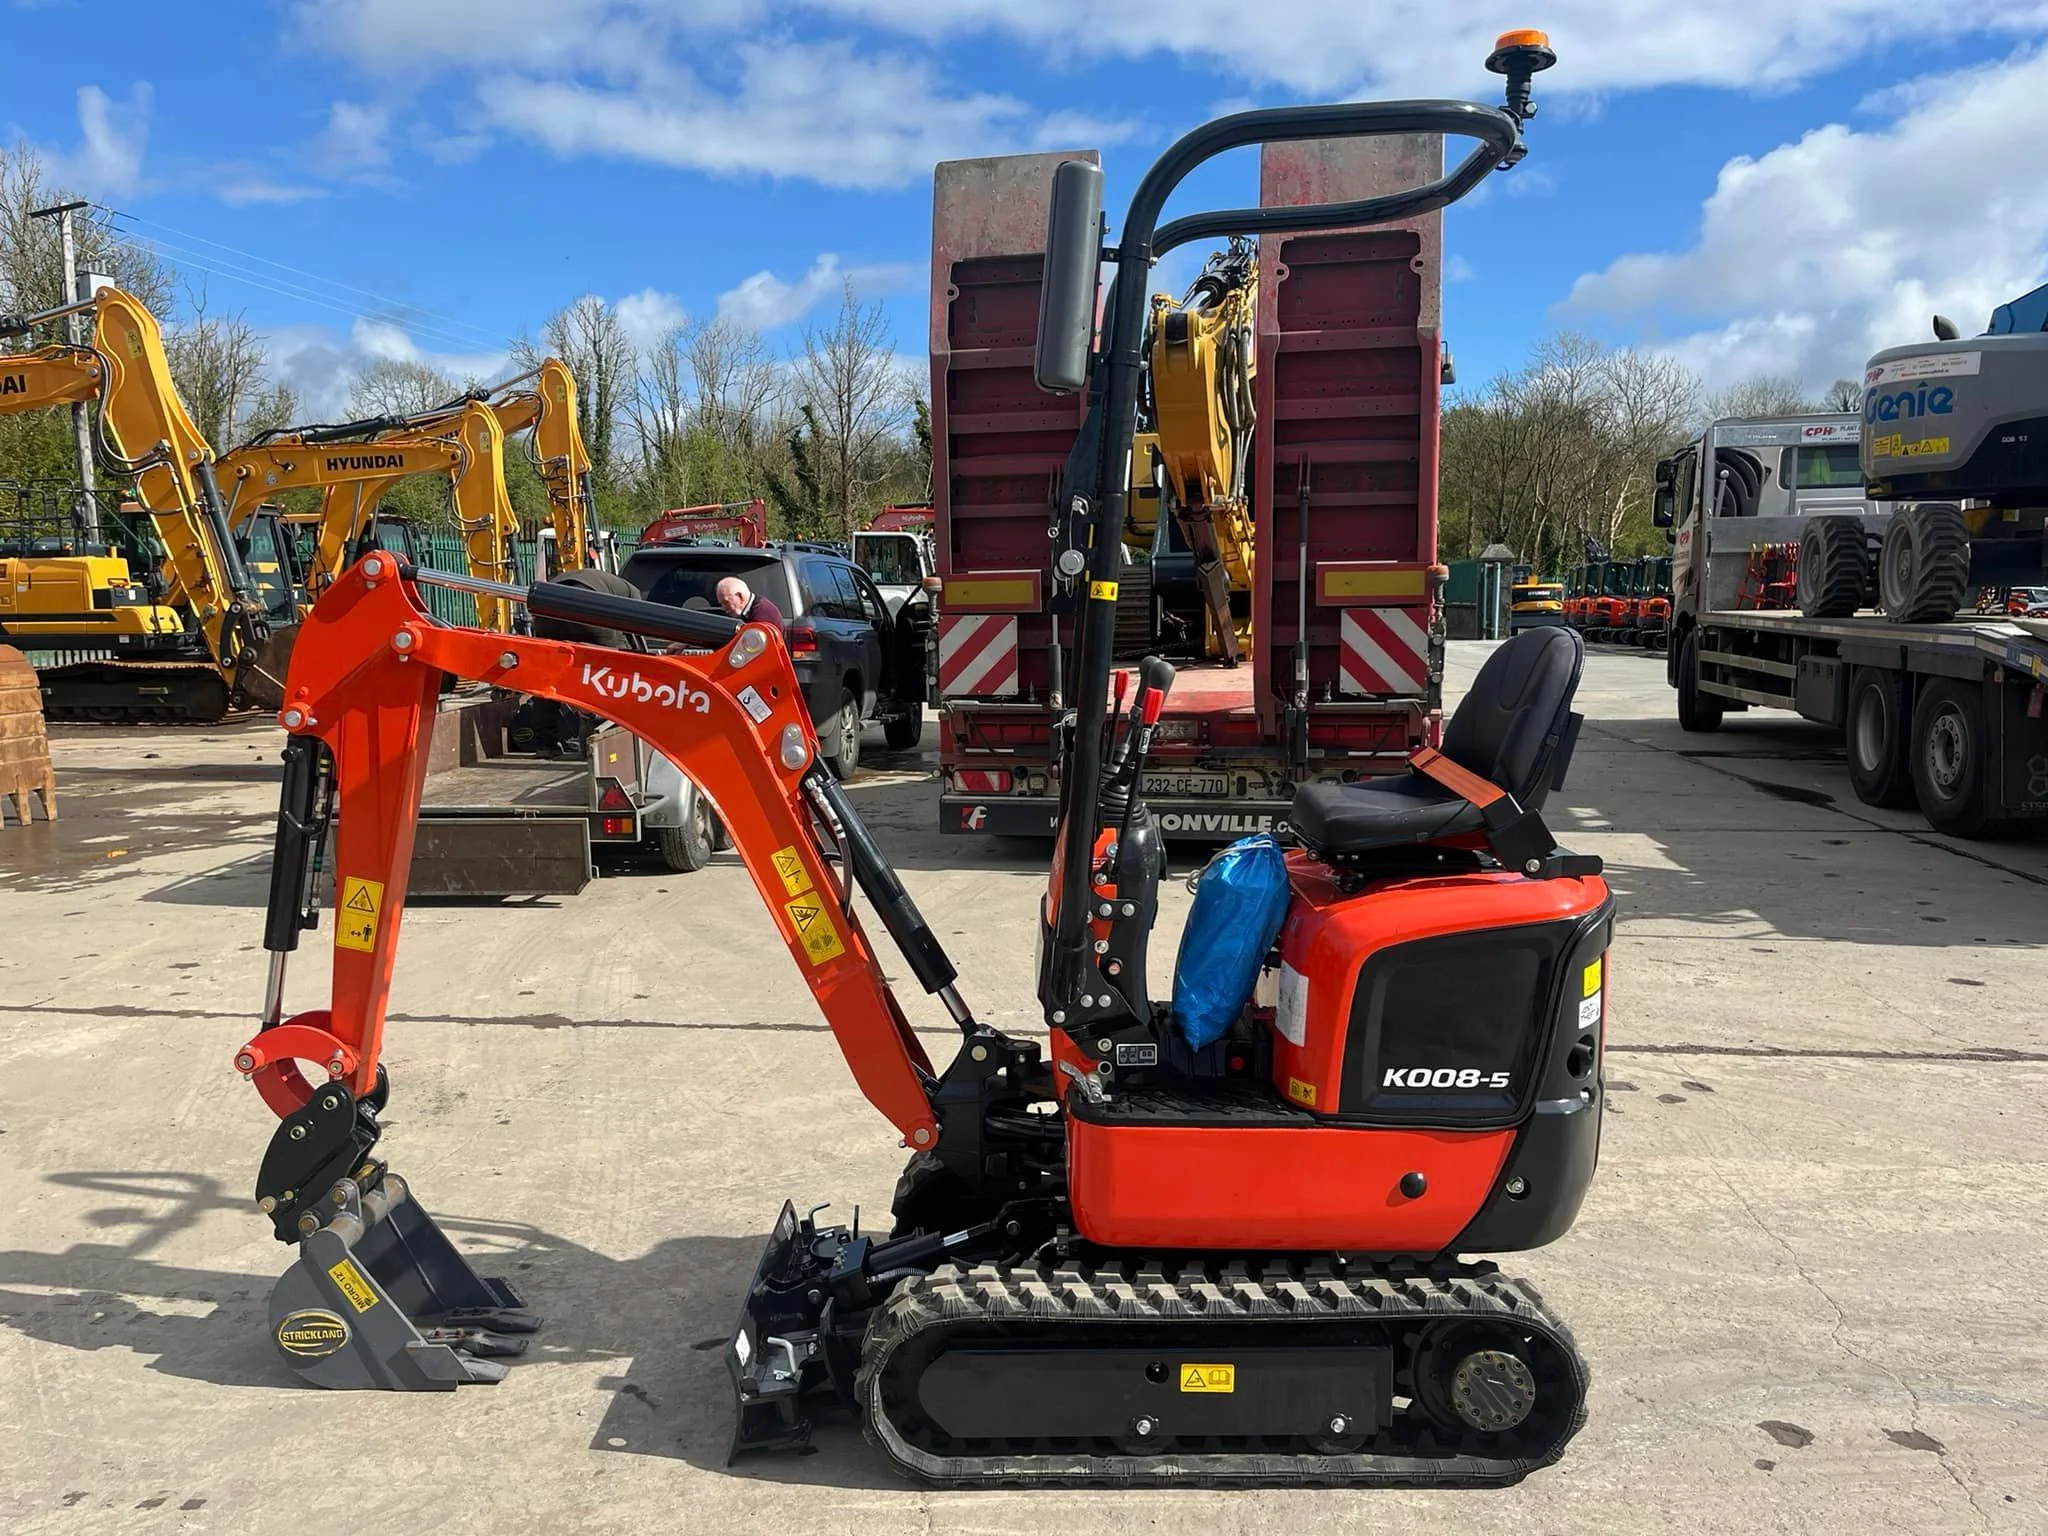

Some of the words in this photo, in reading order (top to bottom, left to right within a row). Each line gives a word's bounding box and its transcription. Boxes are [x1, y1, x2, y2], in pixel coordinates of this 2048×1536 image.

[1865, 381, 1954, 425] Genie
[1806, 426, 1833, 437] CPH
[326, 454, 404, 471] HYUNDAI
[582, 663, 711, 714] Kubota
[1146, 778, 1223, 793] 232-CE-770
[1382, 1067, 1510, 1088] K008-5
[344, 1283, 366, 1309] MICRO
[282, 1329, 344, 1341] STRICKLAND
